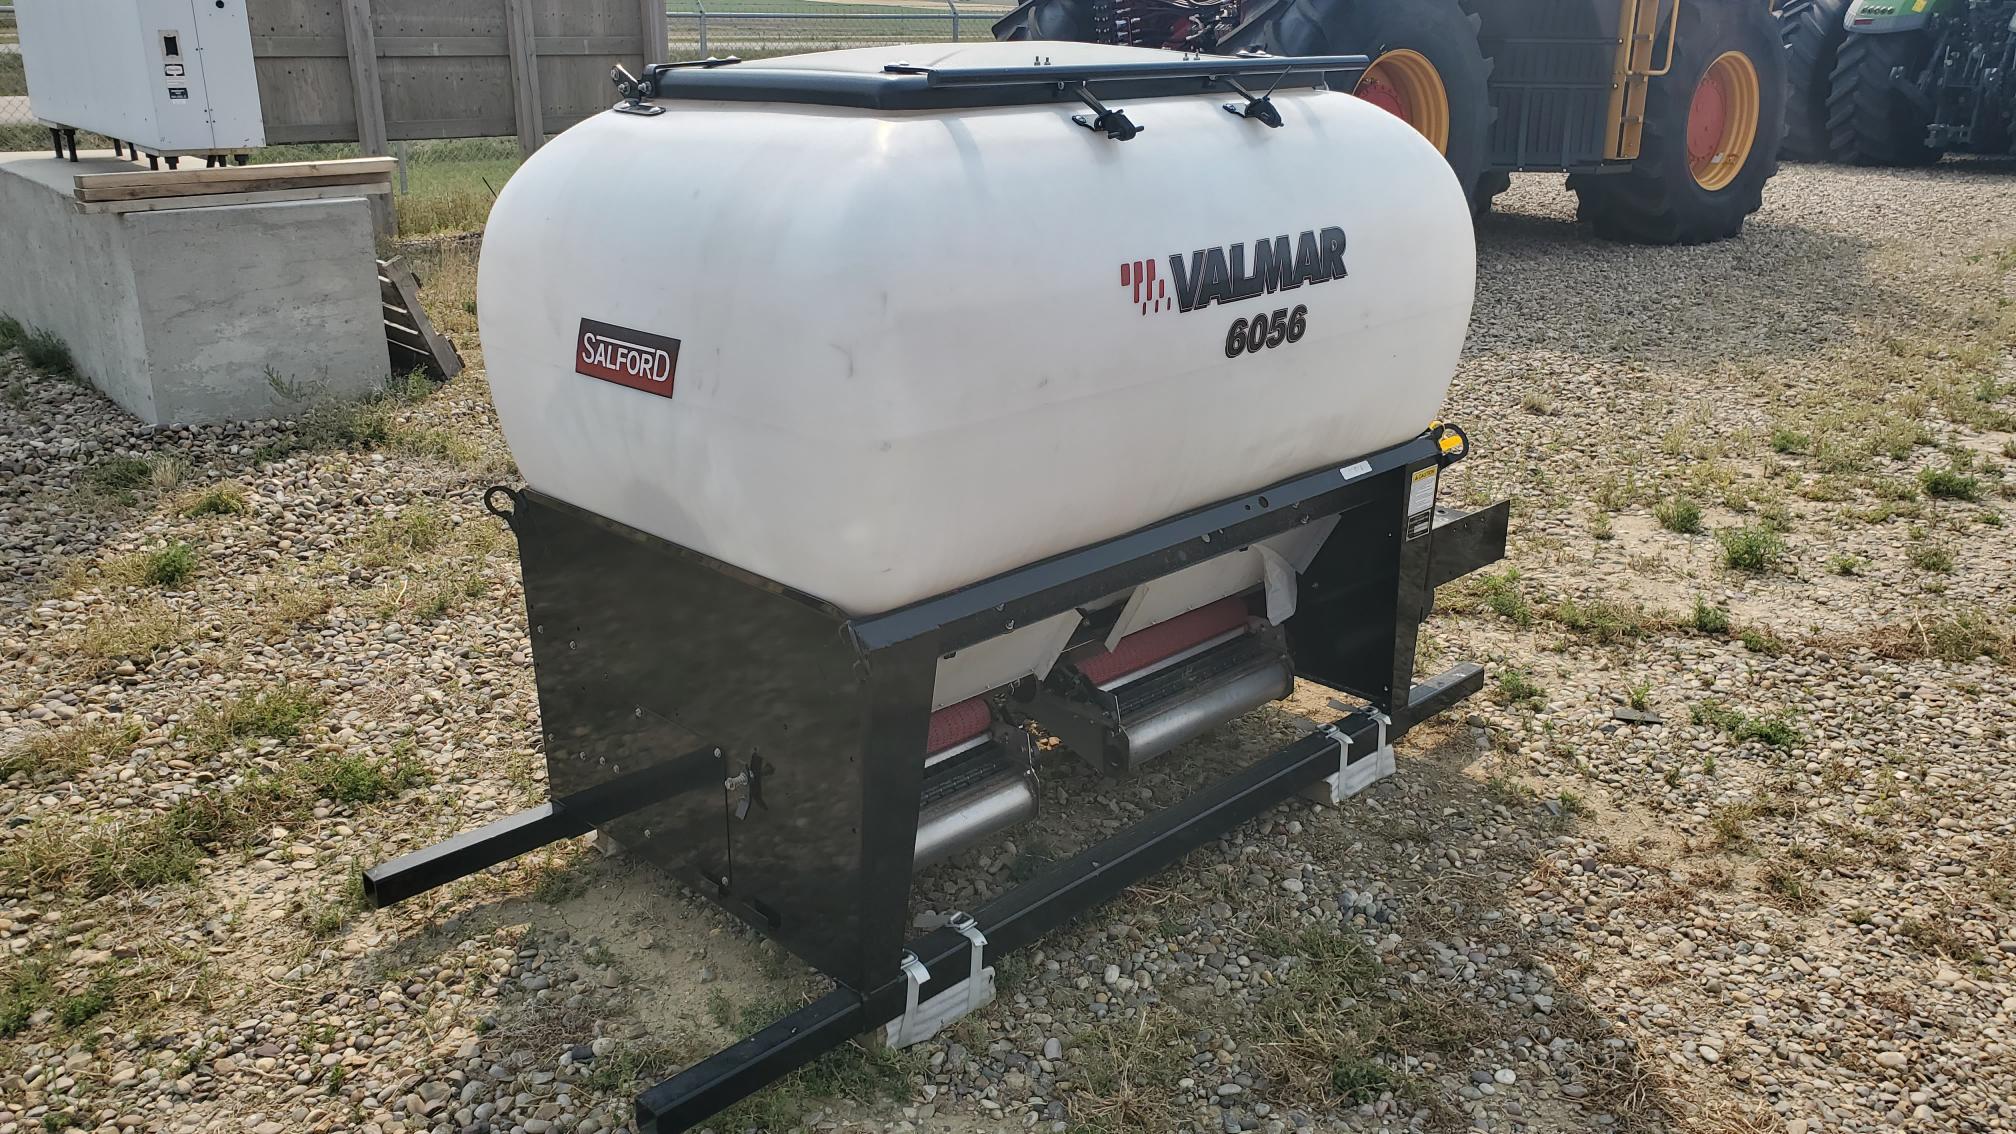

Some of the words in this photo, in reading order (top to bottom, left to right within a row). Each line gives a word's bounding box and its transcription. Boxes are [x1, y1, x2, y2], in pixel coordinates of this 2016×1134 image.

[1168, 225, 1348, 313] VALMAR
[581, 332, 671, 382] SALFORD
[1224, 304, 1309, 359] 6056
